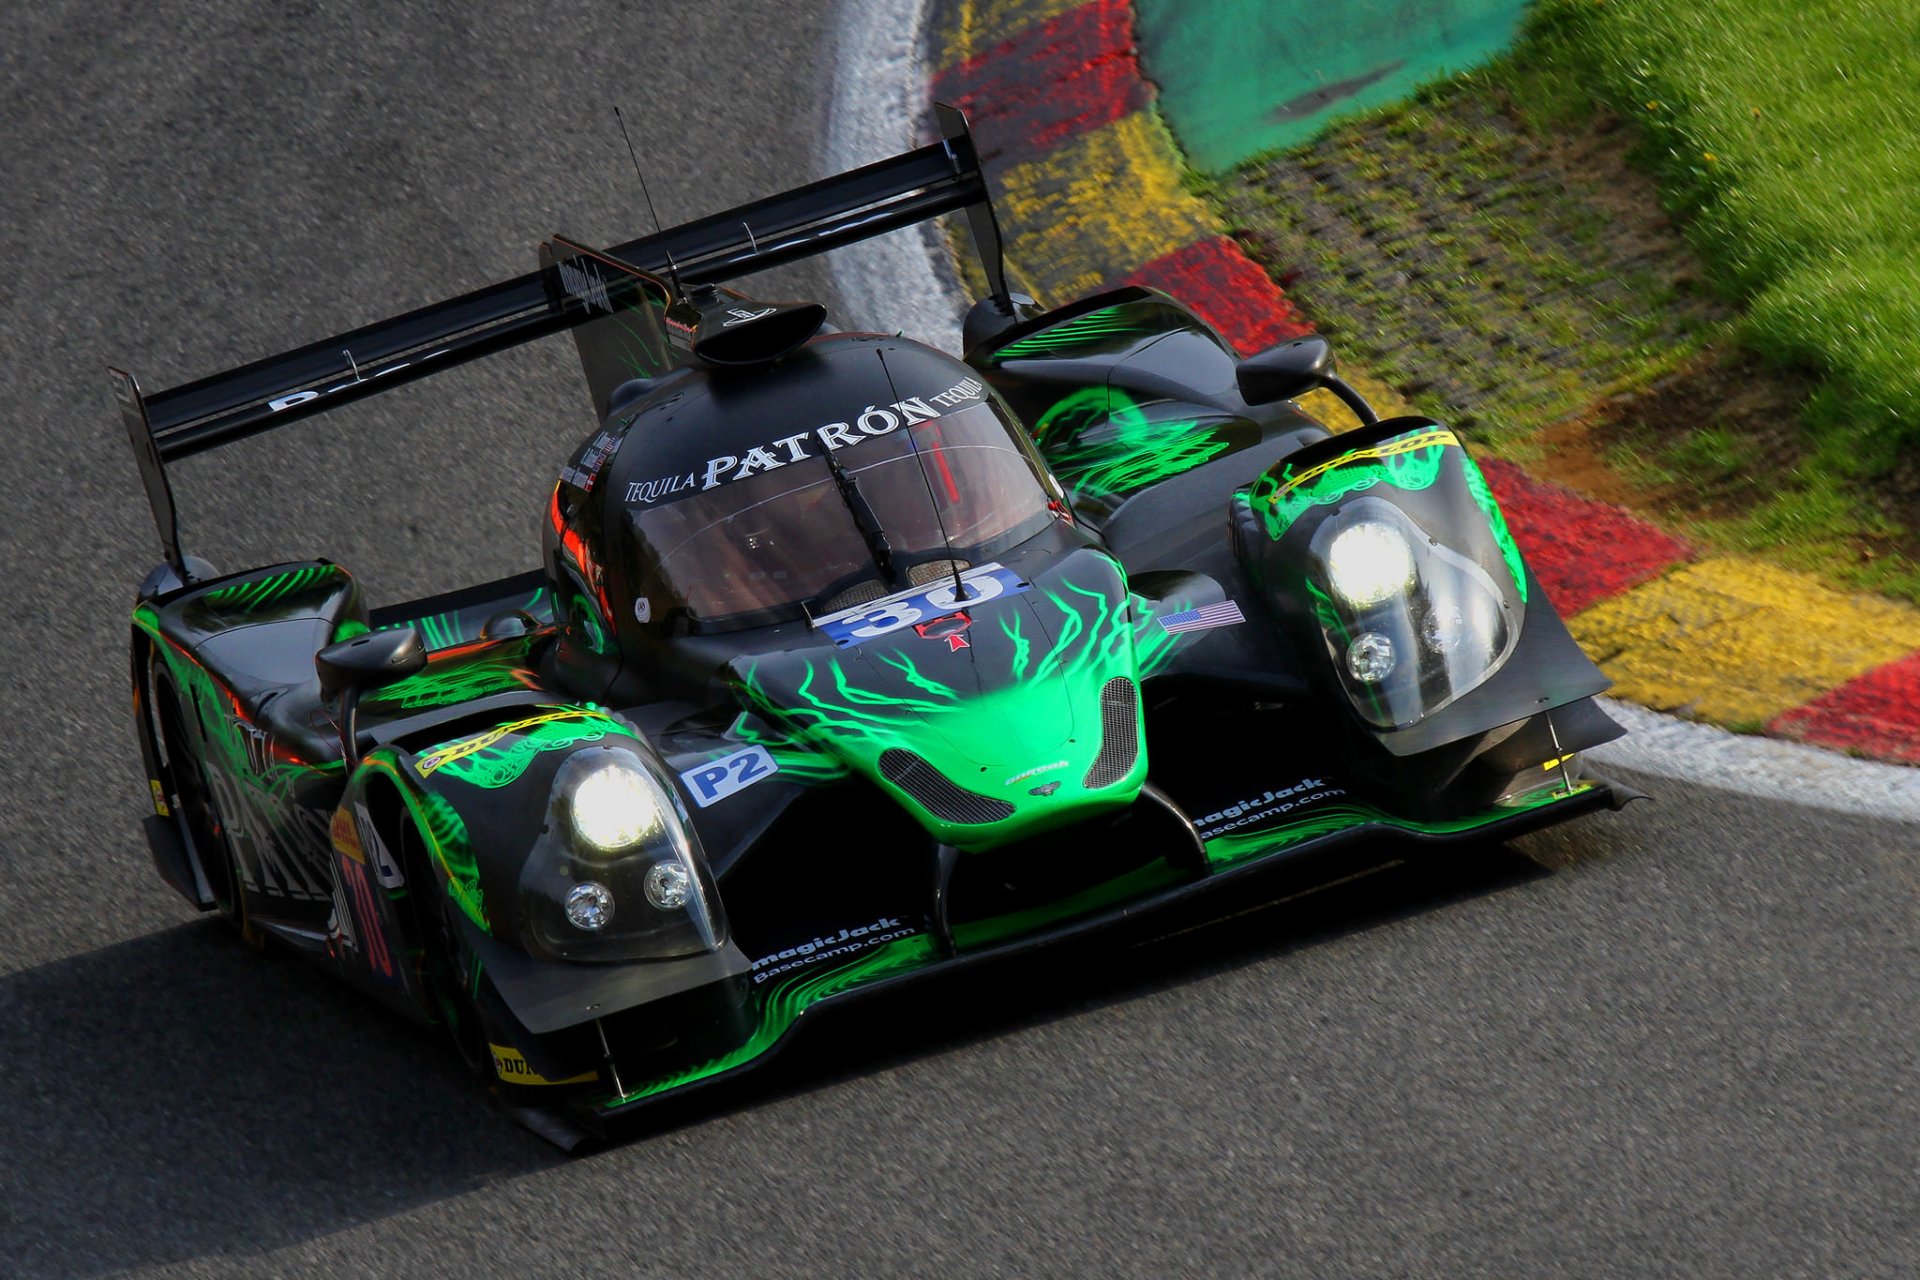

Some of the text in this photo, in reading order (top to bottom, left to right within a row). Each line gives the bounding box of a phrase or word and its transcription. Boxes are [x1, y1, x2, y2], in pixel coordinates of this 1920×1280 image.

[624, 472, 697, 503] TEQUILA
[701, 396, 942, 491] PATRÓN
[842, 576, 1004, 637] 30
[692, 752, 769, 800] P2
[1200, 788, 1346, 840] asecamp.com
[751, 917, 901, 971] magicJack
[753, 926, 916, 985] Basecamp.com
